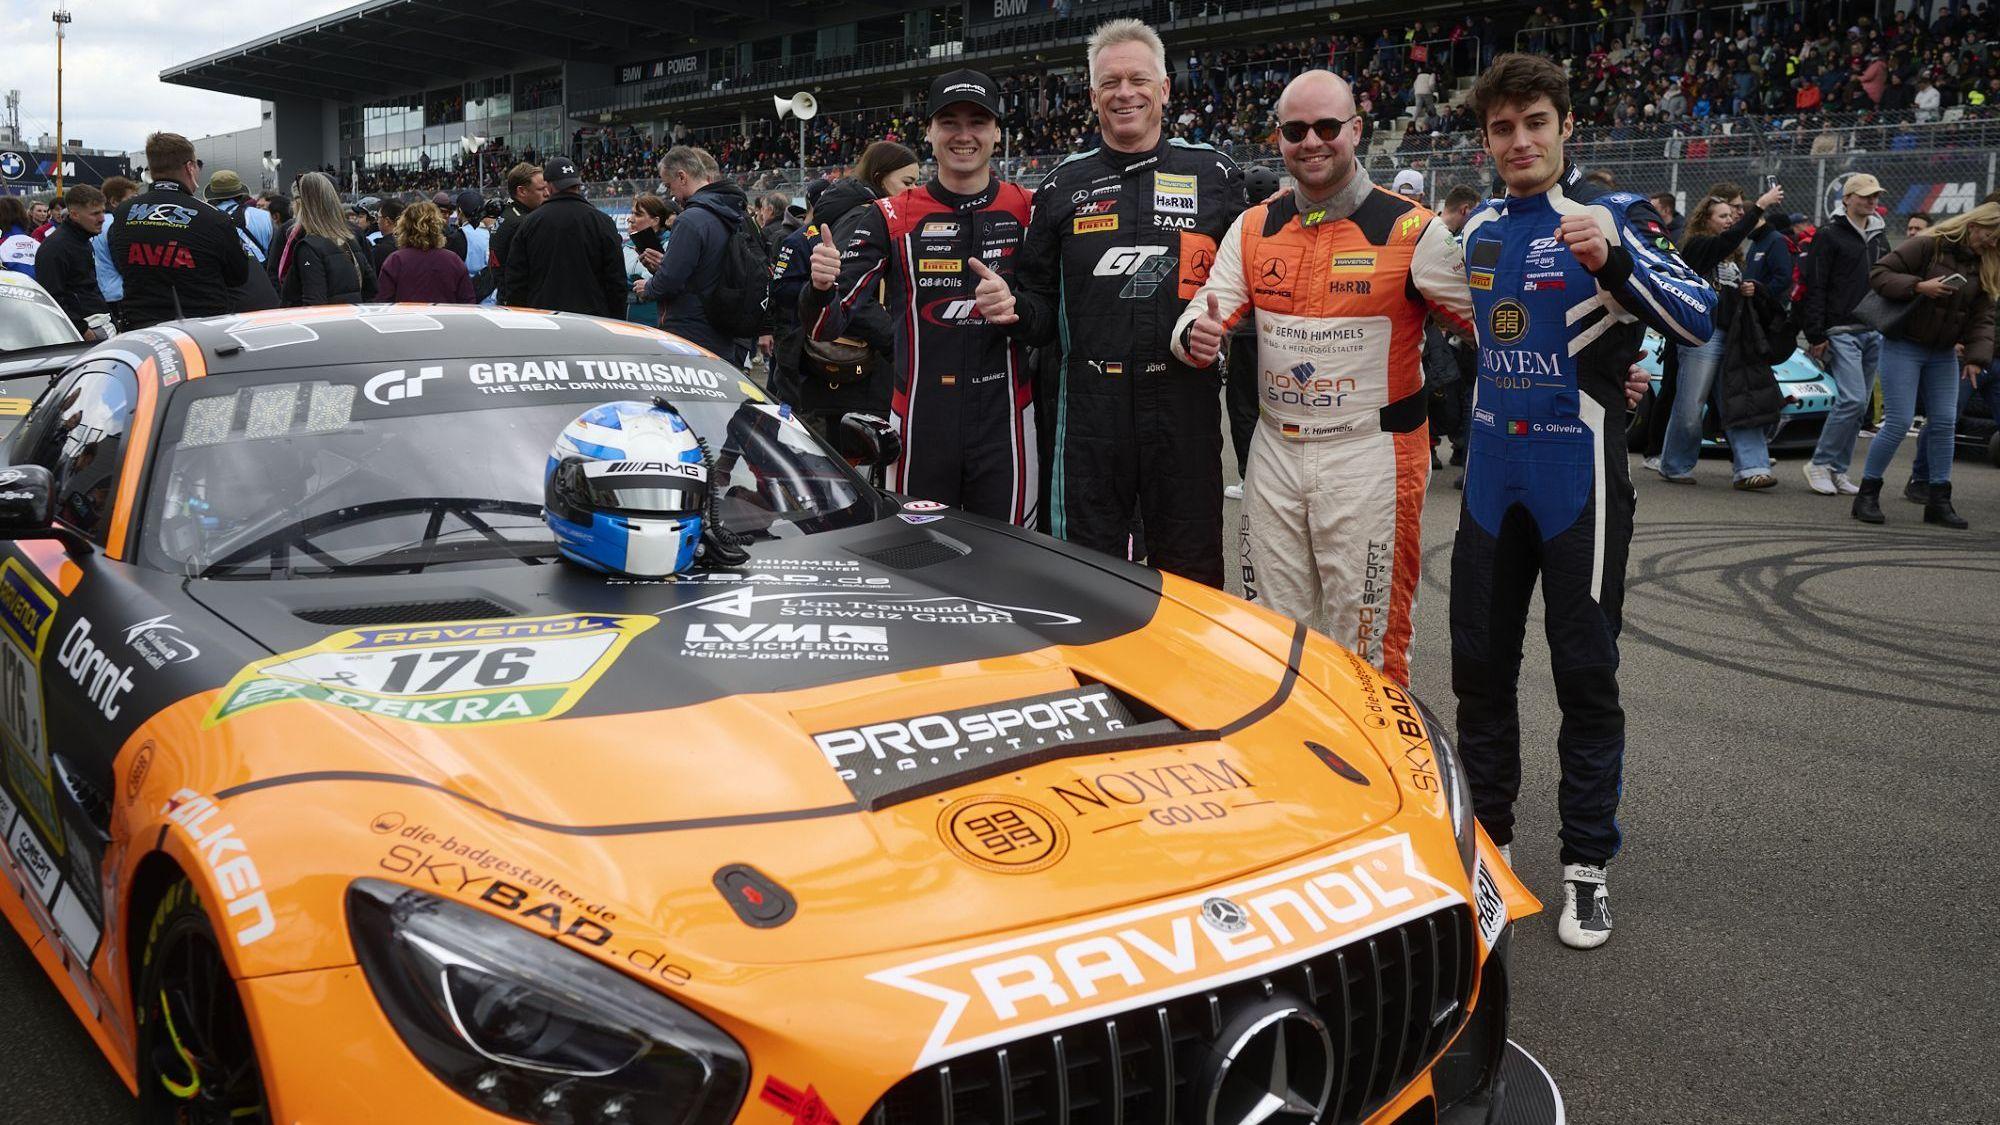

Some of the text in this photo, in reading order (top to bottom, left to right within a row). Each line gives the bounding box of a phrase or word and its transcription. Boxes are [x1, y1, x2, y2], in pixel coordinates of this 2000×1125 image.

[993, 0, 1028, 18] BMW
[622, 66, 642, 82] BMW
[667, 56, 697, 75] POWER
[1156, 195, 1179, 207] H&R
[127, 203, 199, 226] W&S
[1153, 214, 1197, 229] SAAD
[1305, 210, 1327, 226] P1
[126, 219, 190, 230] MOTORSPORT
[1077, 218, 1114, 231] PIRELLI
[1401, 215, 1422, 238] P1
[923, 261, 959, 270] PIRELLI
[1336, 258, 1372, 267] RAVENOL
[918, 277, 962, 287] Q8 Oils
[1329, 281, 1355, 293] H&R
[1276, 327, 1364, 341] BERND HIMMELS
[1145, 362, 1167, 373] JÖRG
[1482, 346, 1563, 377] NOVEM
[468, 360, 570, 385] GRAN
[1264, 369, 1356, 393] noven
[478, 382, 728, 399] THE REAL DRIVING SIMULATOR
[1496, 377, 1531, 390] GOLD
[1267, 386, 1348, 407] solar
[1303, 424, 1353, 435] Y. Himmels
[1533, 423, 1583, 434] G. Oliveira
[641, 461, 700, 478] AMG
[756, 559, 860, 567] HIMMELS
[779, 606, 1017, 624] Schweiz GmbH
[781, 599, 968, 614] Lkm Treuhand
[373, 618, 608, 645] RAVENOL
[684, 622, 822, 643] LVM
[680, 648, 890, 661] Heinz-Josef Frenken
[684, 641, 889, 653] VERSICHERUNG
[57, 616, 135, 721] Dorint
[379, 646, 536, 695] 176
[325, 690, 534, 722] DEKRA
[1383, 686, 1439, 794] SKYBAD
[1048, 757, 1257, 817] NOVEM
[1151, 800, 1229, 827] GOLD
[159, 787, 277, 947] FALKEN
[400, 818, 617, 923] die-badgestalter.de
[379, 843, 692, 987] SKYBAD.de
[1475, 878, 1499, 938] H&R
[969, 864, 1417, 1020] RAVENOL
